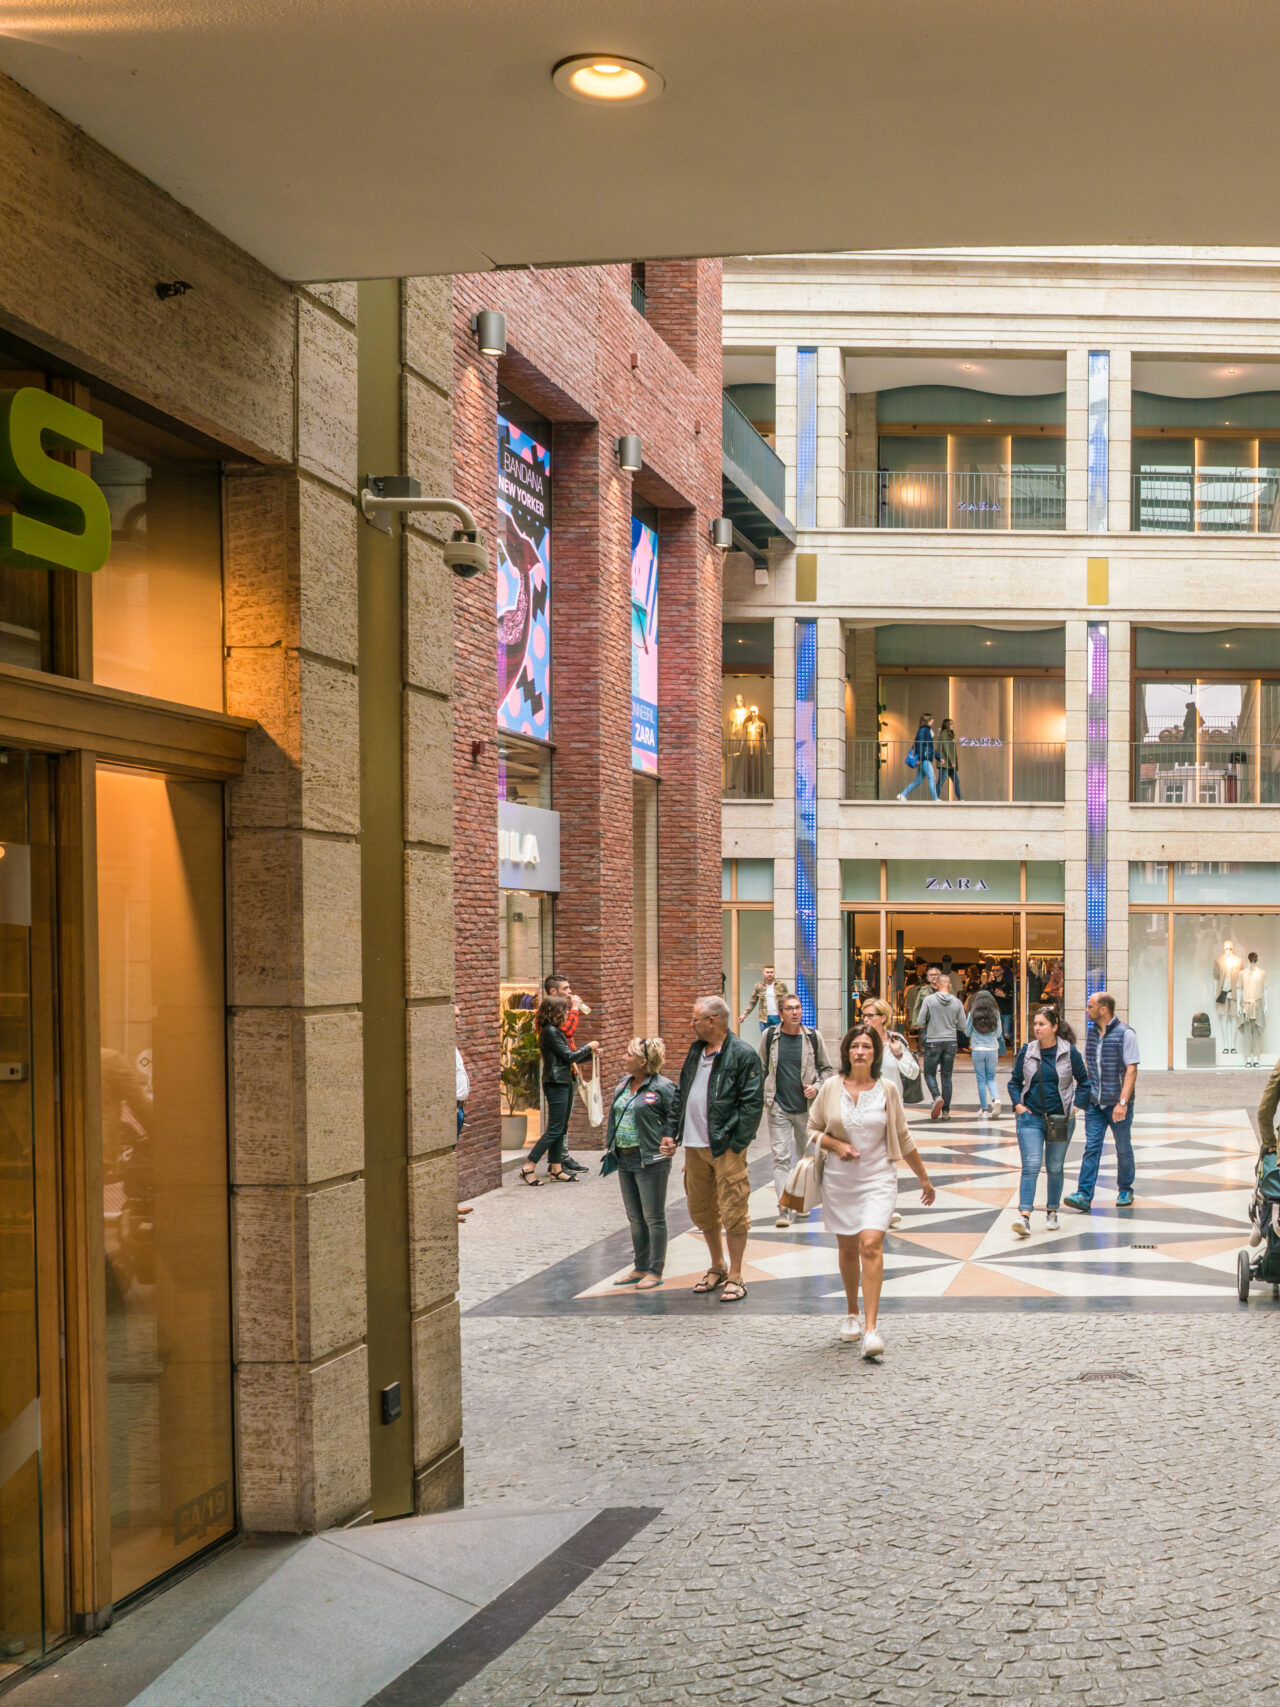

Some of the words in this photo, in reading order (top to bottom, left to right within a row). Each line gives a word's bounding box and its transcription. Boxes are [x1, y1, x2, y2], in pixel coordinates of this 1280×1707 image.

[503, 451, 544, 496] BANDANA
[498, 473, 516, 499] NEW
[516, 486, 545, 518] YORKER
[957, 501, 1001, 511] ZARA
[635, 723, 656, 748] ZARA
[960, 737, 1003, 747] ZARA
[925, 878, 989, 891] ZARA
